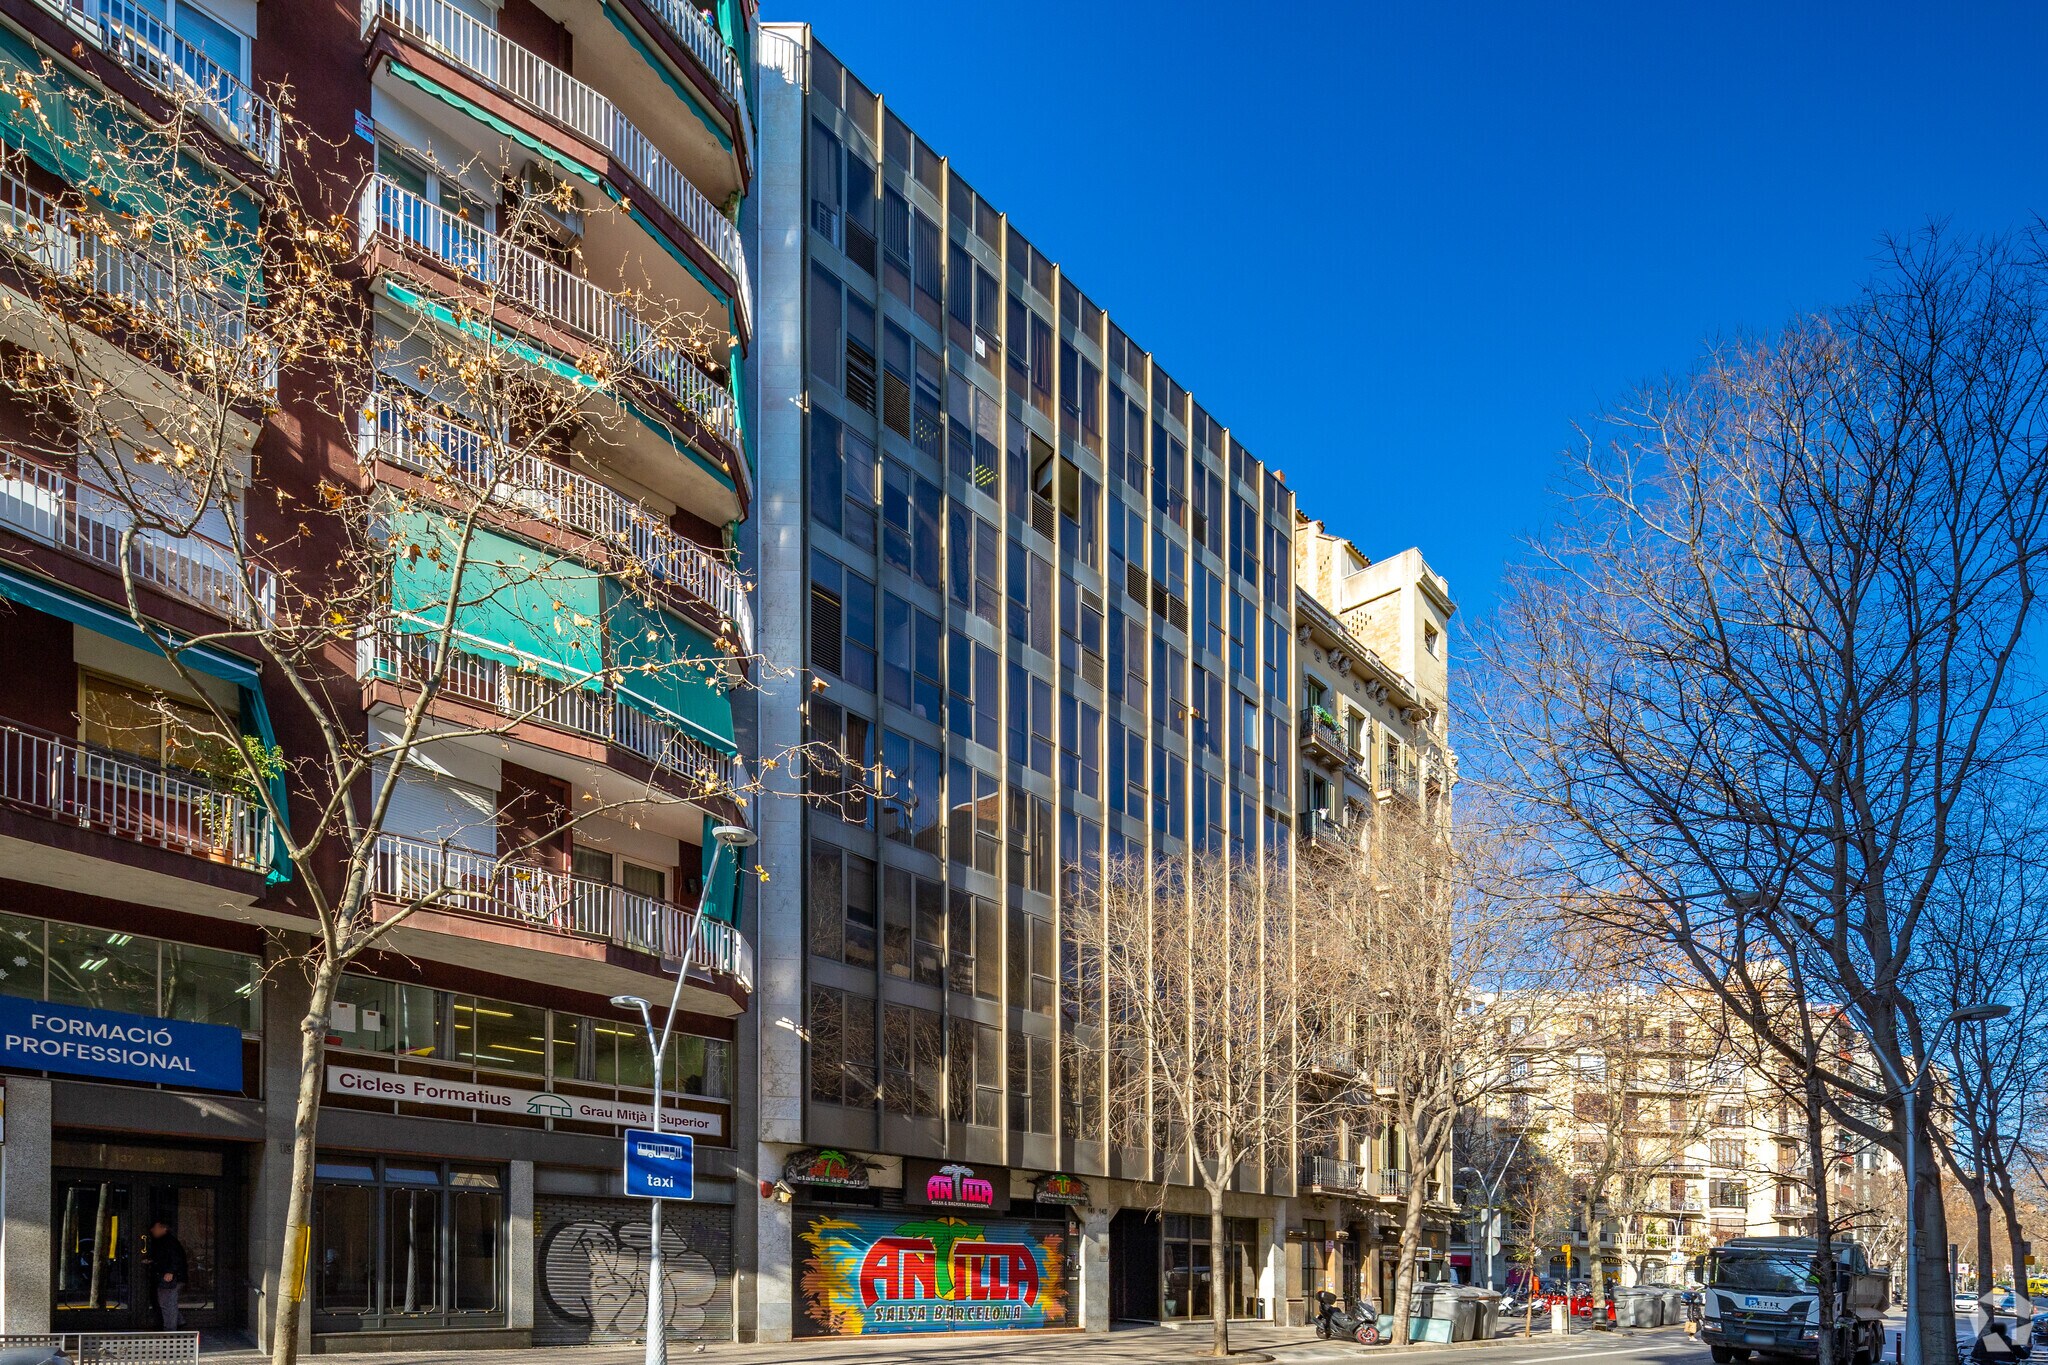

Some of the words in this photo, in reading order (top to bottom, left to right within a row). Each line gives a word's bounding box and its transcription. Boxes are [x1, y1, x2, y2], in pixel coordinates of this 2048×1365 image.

[31, 1013, 173, 1047] FORMACIÓ
[5, 1034, 196, 1072] PROFESSIONAL
[339, 1073, 406, 1095] Cicles
[414, 1082, 512, 1106] Formatius
[580, 1104, 612, 1118] Grau
[617, 1108, 647, 1124] Mitjà
[661, 1113, 710, 1130] Superior
[646, 1173, 674, 1188] taxi
[797, 1175, 830, 1183] classes
[927, 1165, 993, 1206] ANTILLA
[859, 1224, 1040, 1310] ANTILLA
[875, 1305, 926, 1322] SALSA
[933, 1305, 1022, 1322] BARCELONA
[1748, 1299, 1780, 1308] PETIT
